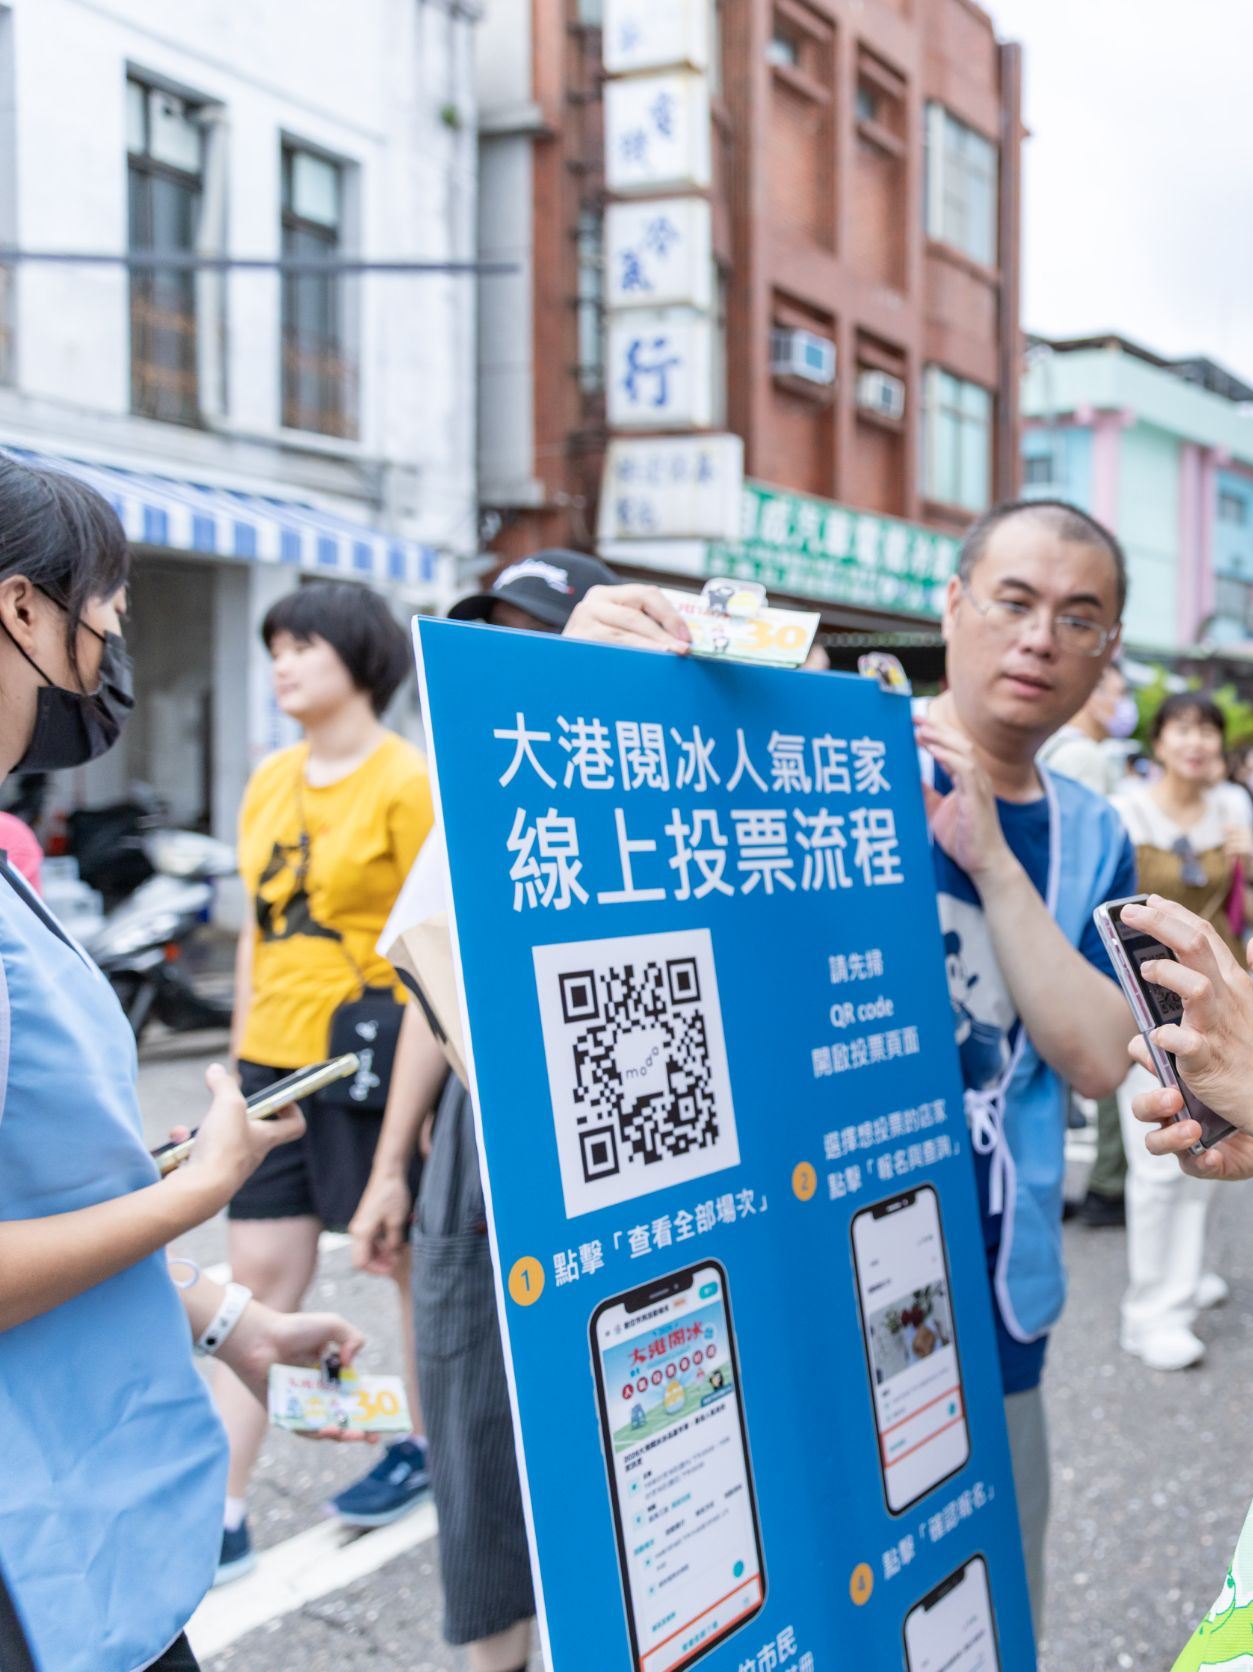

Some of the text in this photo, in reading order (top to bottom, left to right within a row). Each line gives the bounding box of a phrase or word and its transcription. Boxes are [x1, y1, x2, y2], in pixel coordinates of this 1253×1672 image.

[493, 711, 892, 795] 大港閱冰人氣店家
[506, 807, 905, 913] 線上投票流程
[828, 948, 884, 984] 請先掃
[829, 995, 895, 1029] QR code
[519, 1268, 532, 1292] 1
[350, 1389, 400, 1423] 30
